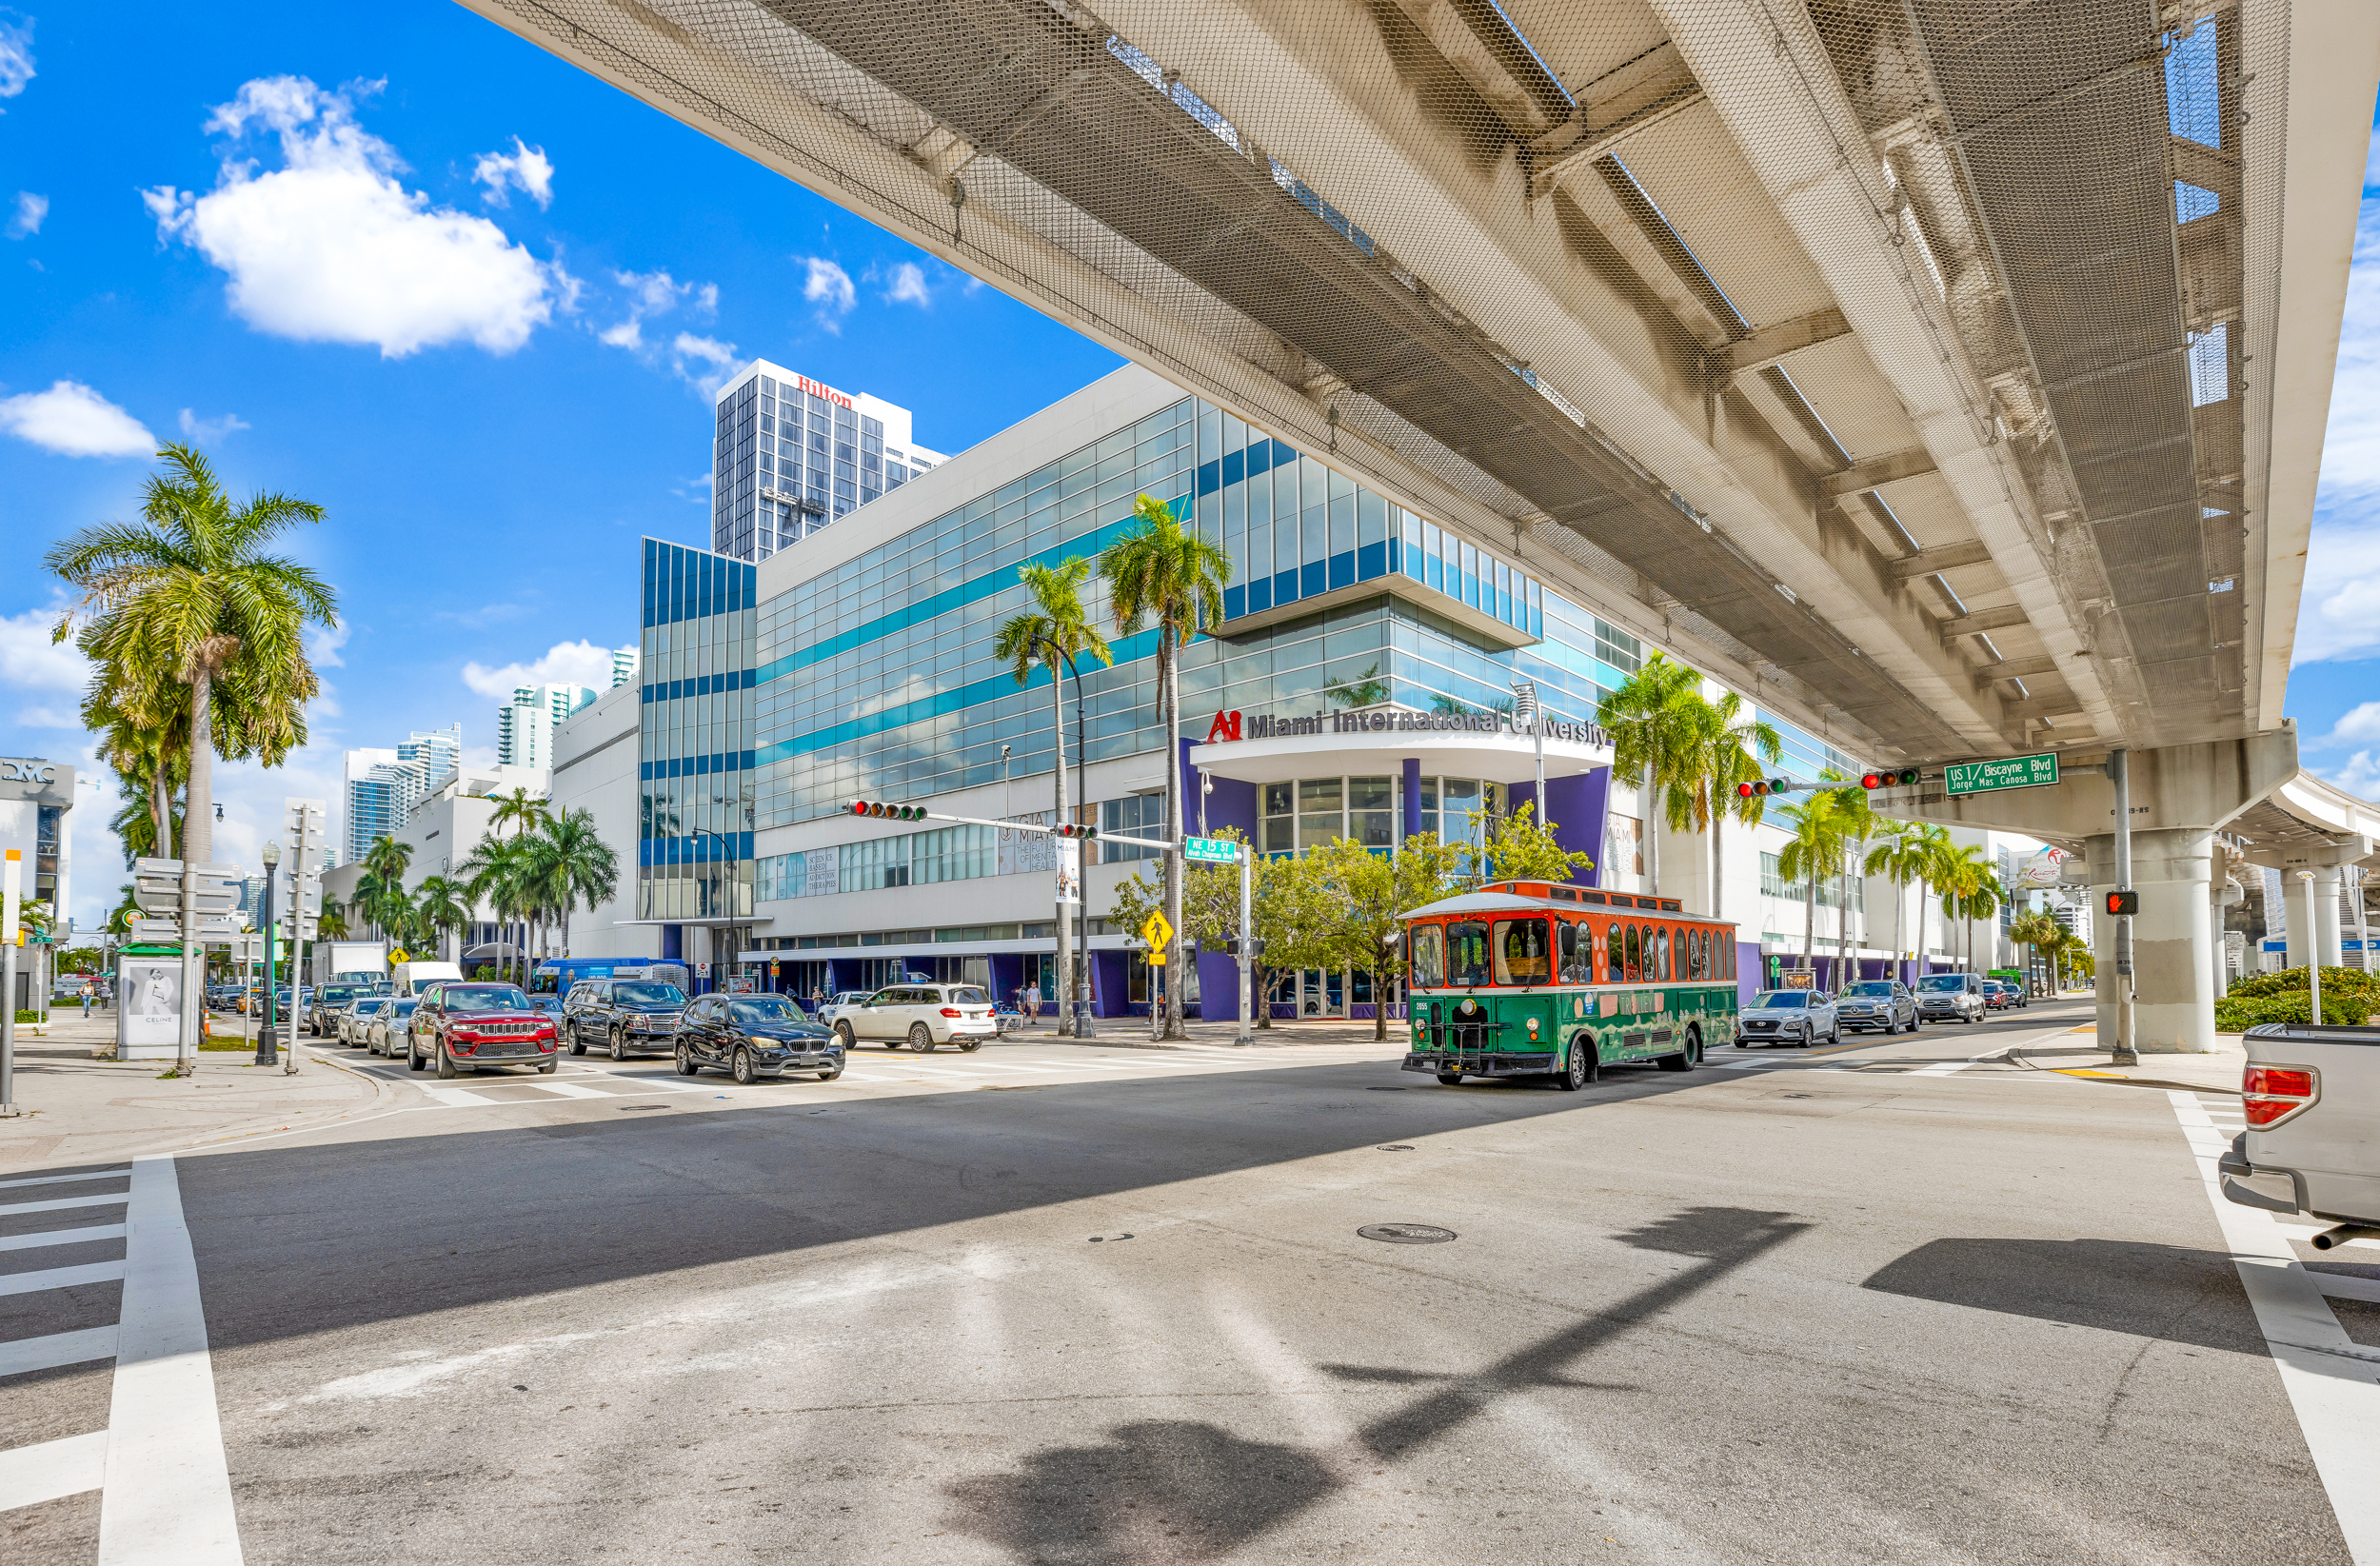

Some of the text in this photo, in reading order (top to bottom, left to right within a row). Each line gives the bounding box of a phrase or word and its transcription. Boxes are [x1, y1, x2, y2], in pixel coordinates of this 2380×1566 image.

[798, 375, 853, 409] Hilton
[1248, 710, 1322, 739] Miami
[1333, 707, 1502, 733] International
[1951, 768, 1963, 781] US
[2031, 759, 2052, 772] Blvd
[1952, 772, 2052, 790] Jorge Mas Canosa Blvd
[1872, 796, 1938, 808] LEARANCE
[1019, 812, 1044, 825] GIA
[1032, 842, 1056, 853] FUTUR
[1192, 840, 1230, 852] NE 15 ST
[809, 854, 834, 864] SCIENCE
[1031, 852, 1056, 862] MENTA
[809, 863, 825, 872] BASED
[1031, 861, 1056, 871] HEALT
[809, 872, 835, 882] ADDICTION
[809, 881, 837, 889] THERAPIES
[1416, 1002, 1428, 1011] 2055
